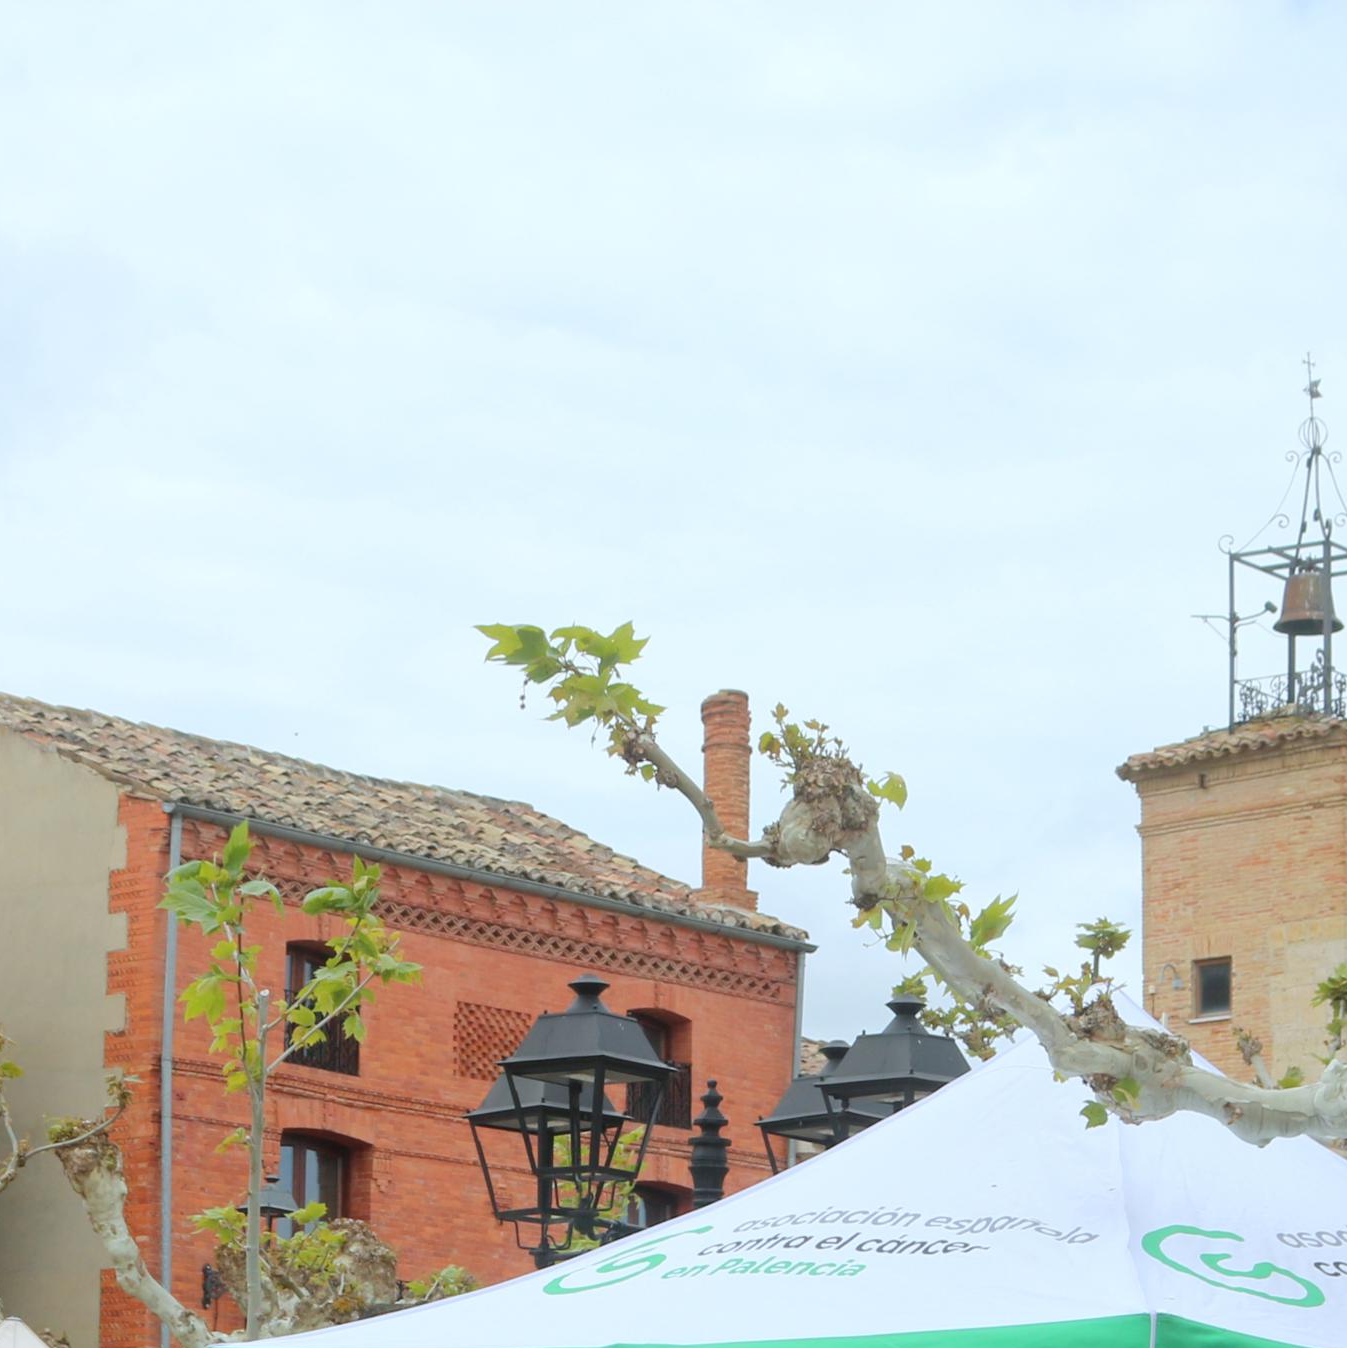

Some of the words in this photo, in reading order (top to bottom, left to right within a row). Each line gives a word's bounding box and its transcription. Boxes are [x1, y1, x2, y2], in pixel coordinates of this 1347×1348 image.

[733, 1205, 921, 1234] asociación
[696, 1232, 815, 1258] contra
[820, 1230, 859, 1252] el
[858, 1232, 992, 1256] cáncer
[660, 1261, 707, 1280] en
[713, 1256, 869, 1279] Palencia
